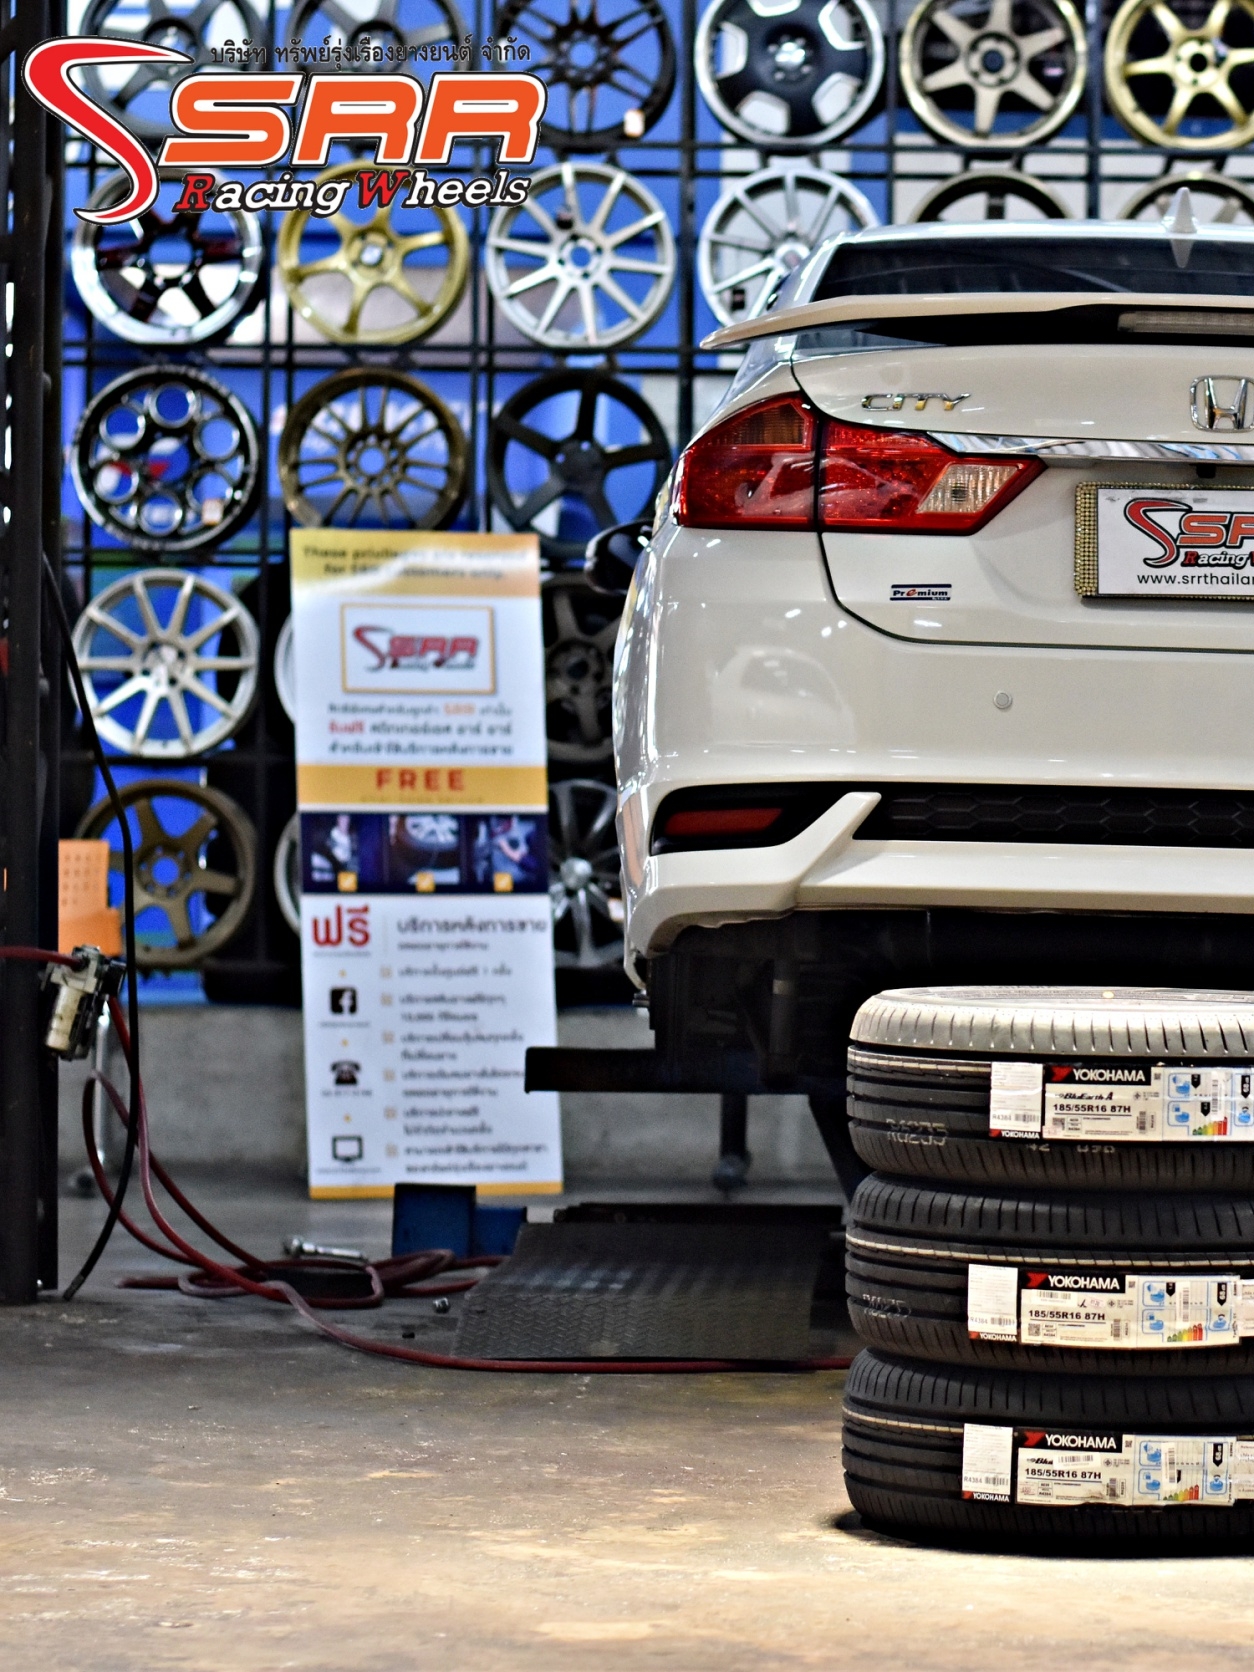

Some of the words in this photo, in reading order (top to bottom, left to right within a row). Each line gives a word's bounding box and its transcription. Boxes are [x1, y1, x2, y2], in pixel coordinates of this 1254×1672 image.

[861, 393, 971, 411] CITY
[1181, 551, 1250, 569] Racing
[893, 588, 948, 597] Premium
[375, 768, 465, 792] FREE
[312, 904, 370, 947] ฟรี
[1073, 1068, 1146, 1082] YOKOHAMA
[1053, 1103, 1107, 1113] 185/55R16
[1110, 1105, 1131, 1113] 87H
[1001, 1130, 1040, 1139] YOKOHAMA
[1048, 1275, 1120, 1290] YOKOHAMA
[1028, 1310, 1081, 1320] 185/55R16
[1085, 1311, 1106, 1321] 87H
[979, 1332, 1017, 1342] YOKOHAMA
[1045, 1434, 1117, 1450] YOKOHAMA
[1025, 1468, 1078, 1479] 185/55R16
[1081, 1470, 1102, 1480] 87H
[972, 1492, 1010, 1502] YOKOHAMA
